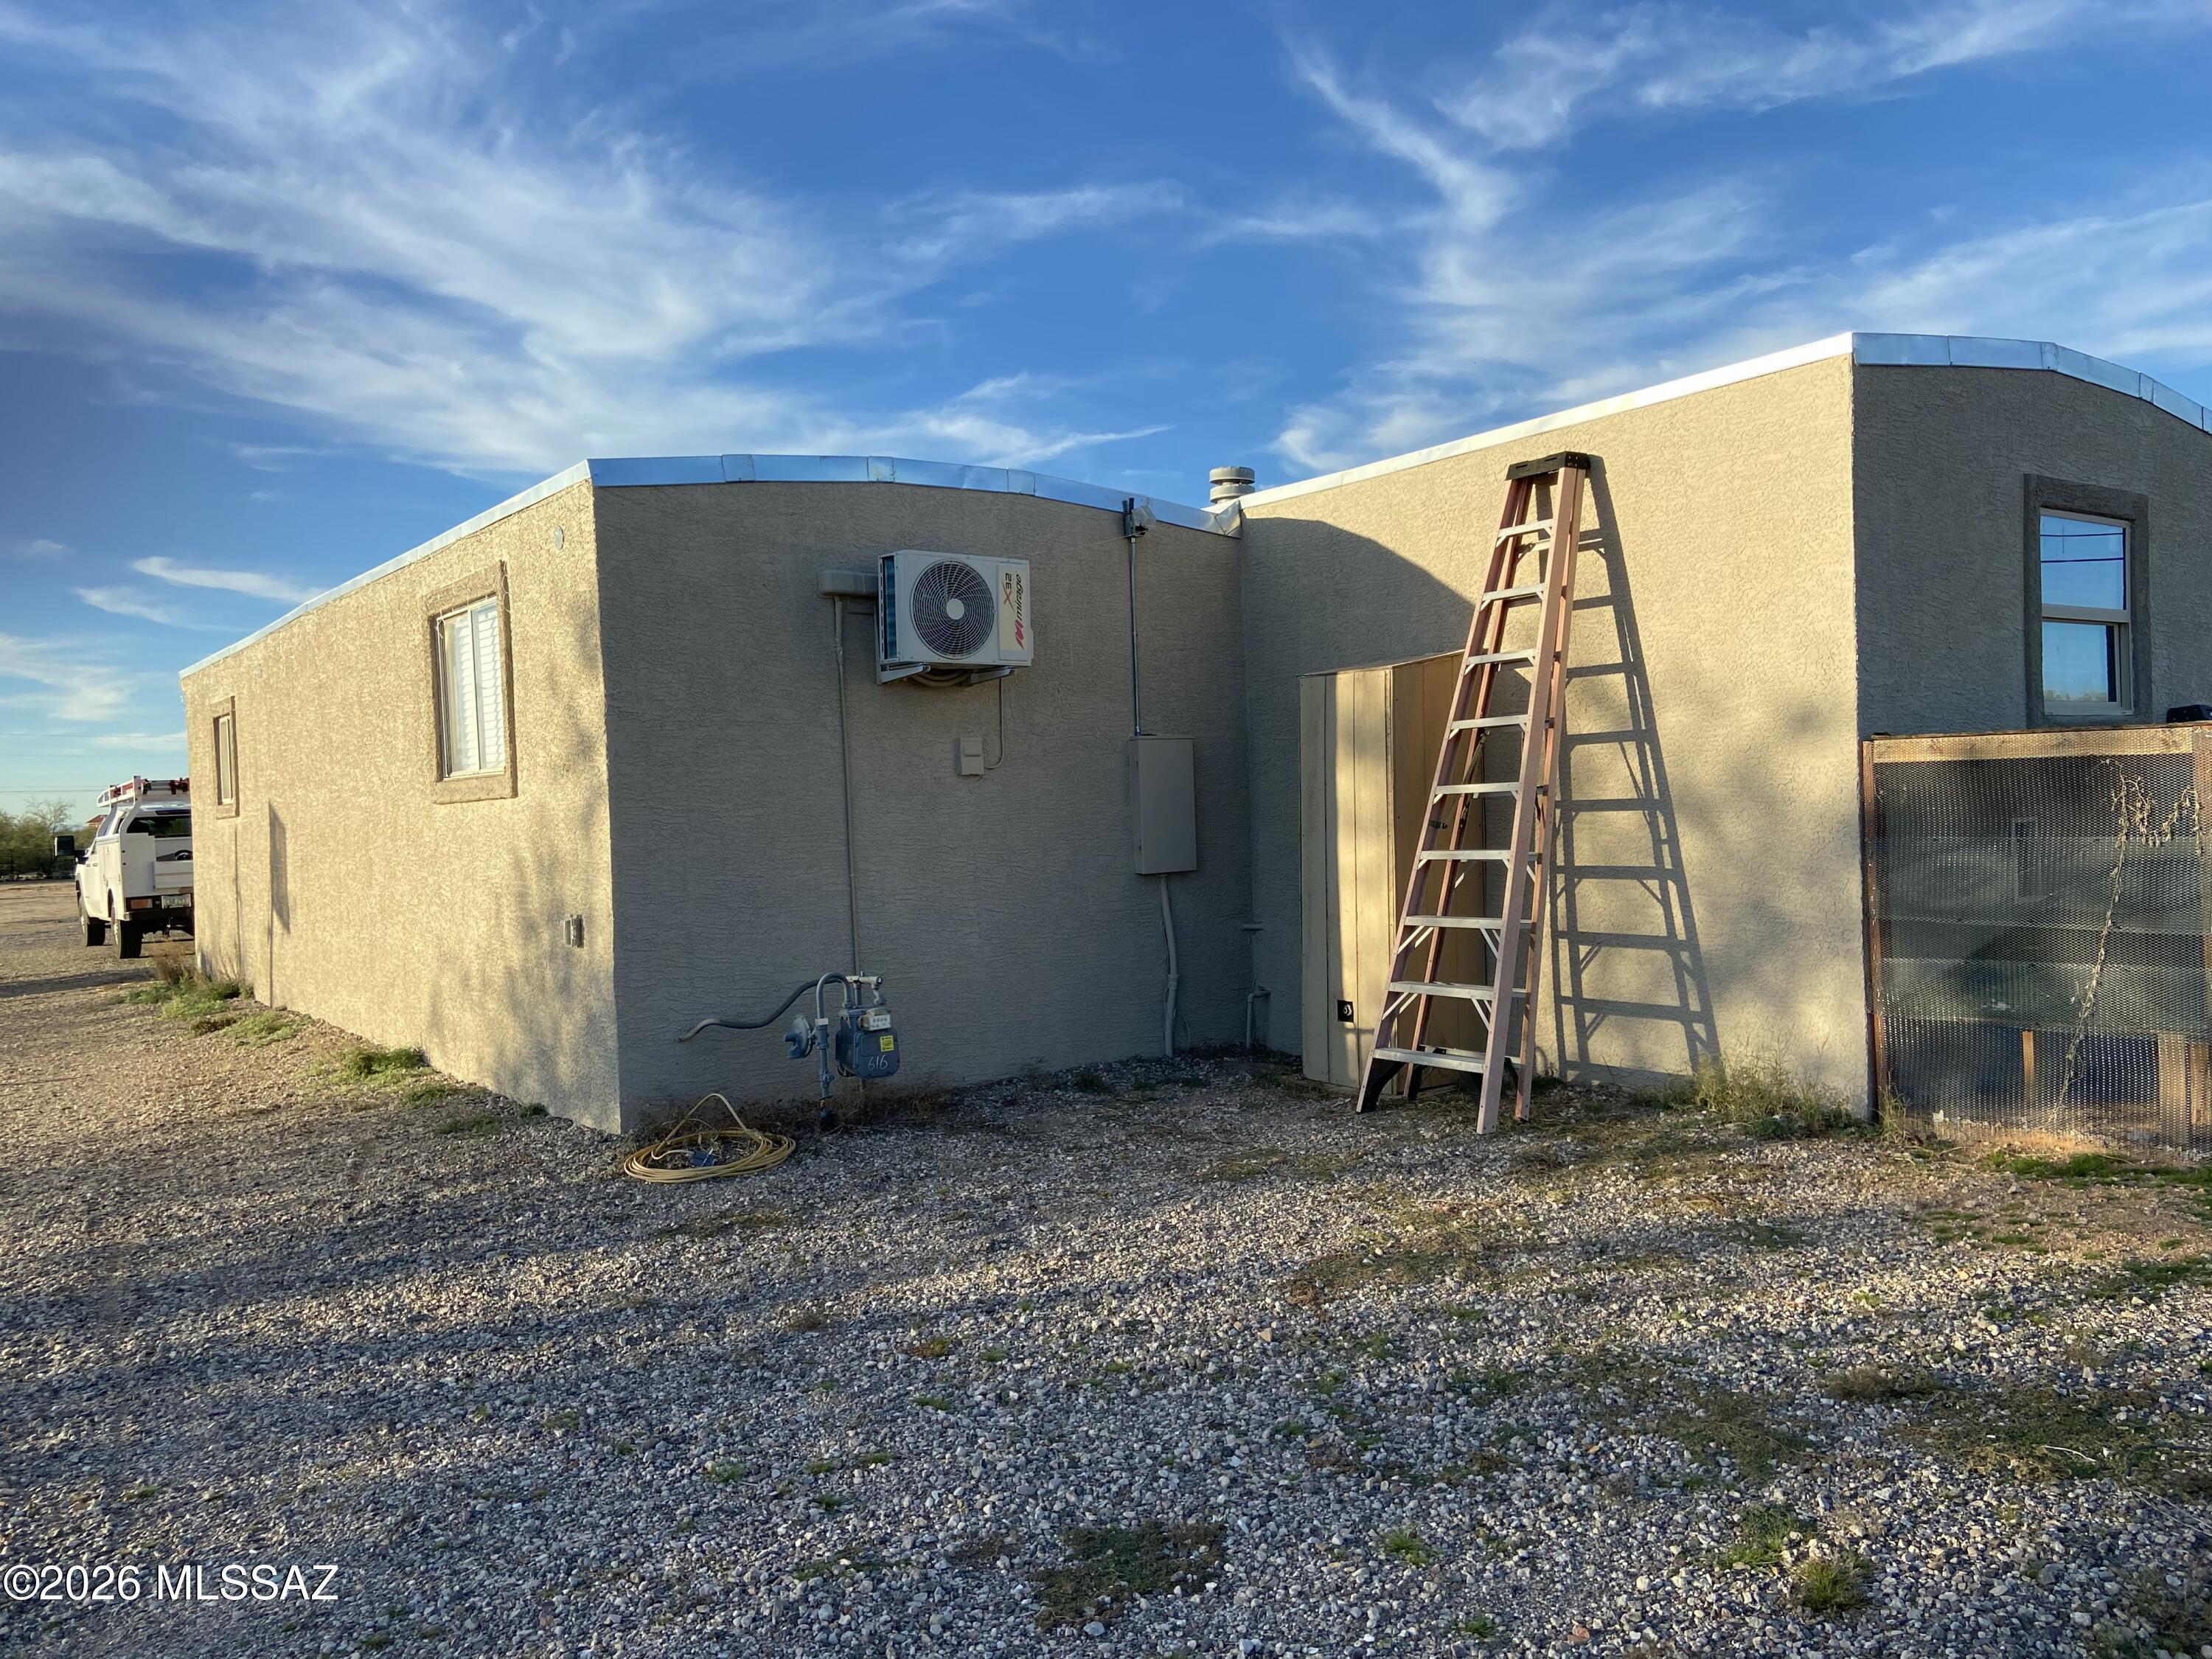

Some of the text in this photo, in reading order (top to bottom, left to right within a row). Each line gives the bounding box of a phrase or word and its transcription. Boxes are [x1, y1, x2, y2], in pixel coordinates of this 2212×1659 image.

[1002, 573, 1015, 611] X32
[1015, 573, 1023, 621] mirage
[868, 1054, 888, 1071] 616
